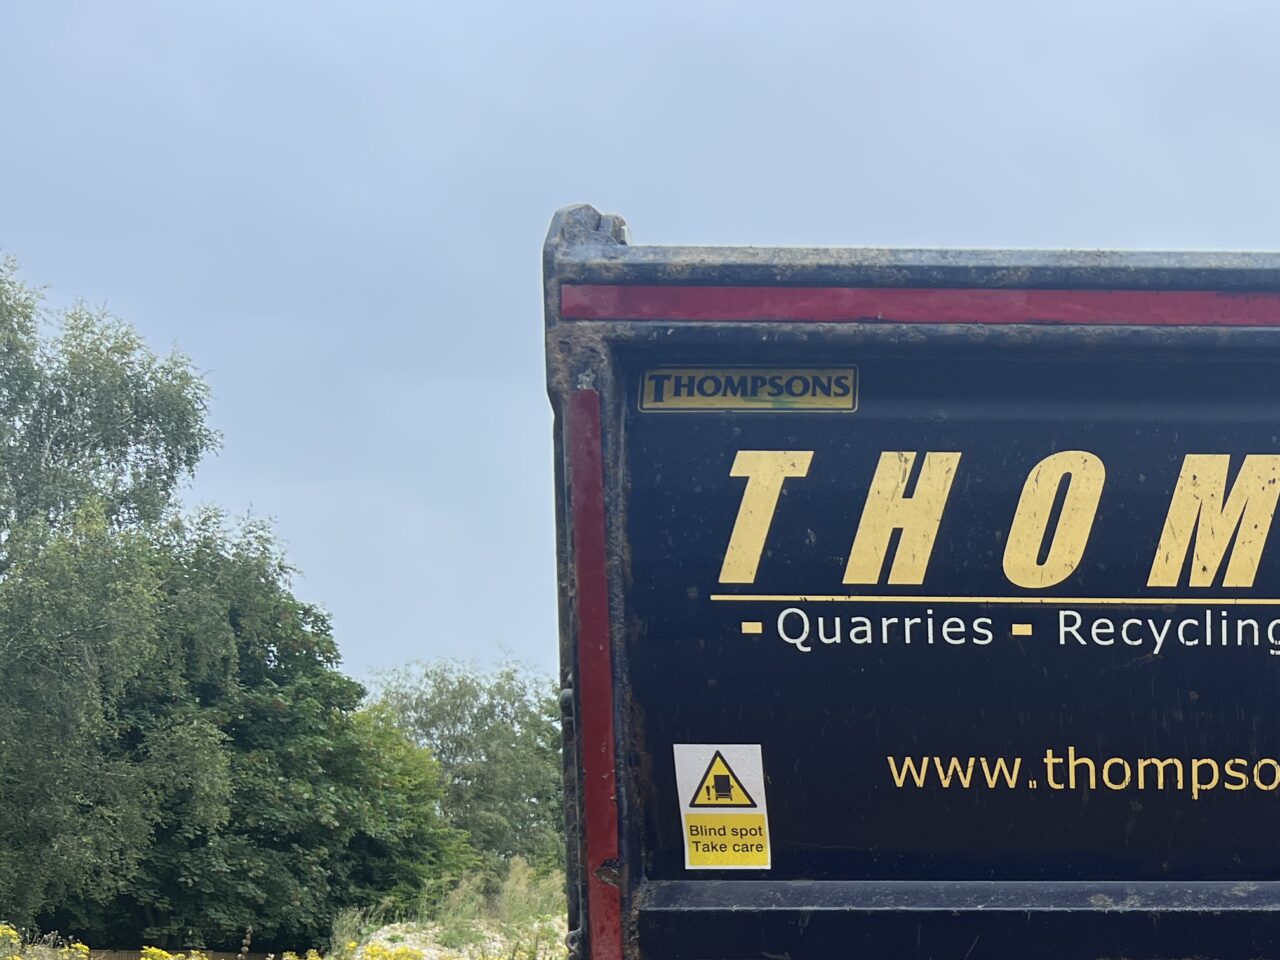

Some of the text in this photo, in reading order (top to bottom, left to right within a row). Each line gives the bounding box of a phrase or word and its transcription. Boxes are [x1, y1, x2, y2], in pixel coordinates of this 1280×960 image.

[648, 374, 851, 403] THOMPSONS
[777, 607, 993, 652] Quarries
[689, 824, 764, 840] Blind spot
[691, 840, 764, 853] Take care
